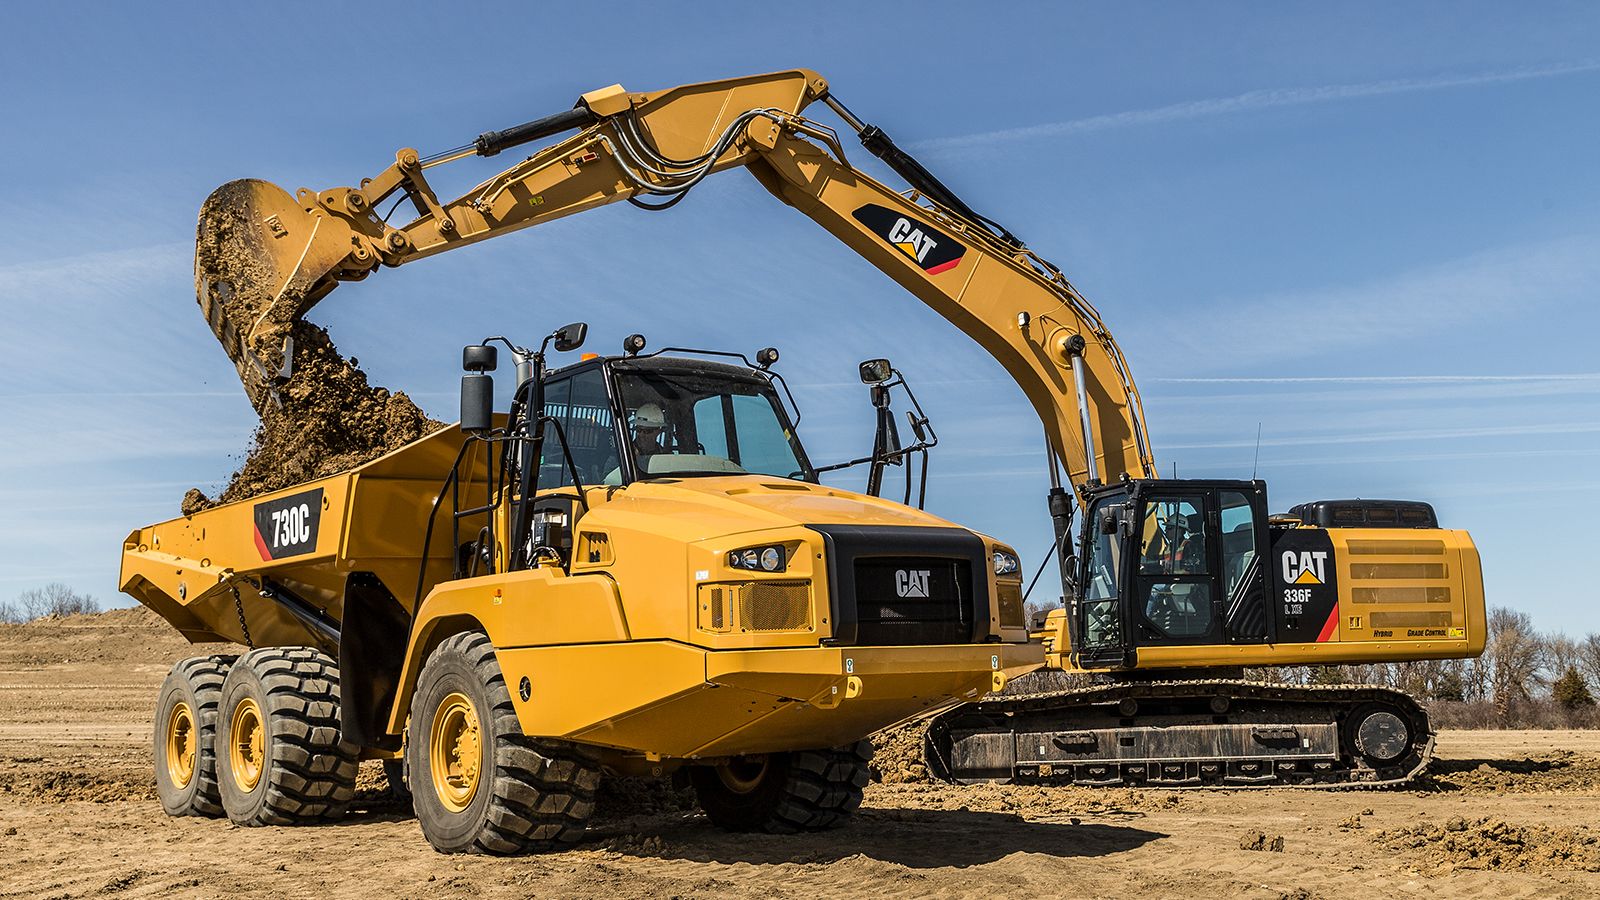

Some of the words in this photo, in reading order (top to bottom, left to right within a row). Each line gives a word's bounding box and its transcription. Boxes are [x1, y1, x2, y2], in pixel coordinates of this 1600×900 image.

[889, 217, 938, 264] CAT
[272, 503, 310, 548] 730C
[895, 569, 931, 598] CAT
[1281, 550, 1328, 584] CAT
[1283, 588, 1312, 603] 336F
